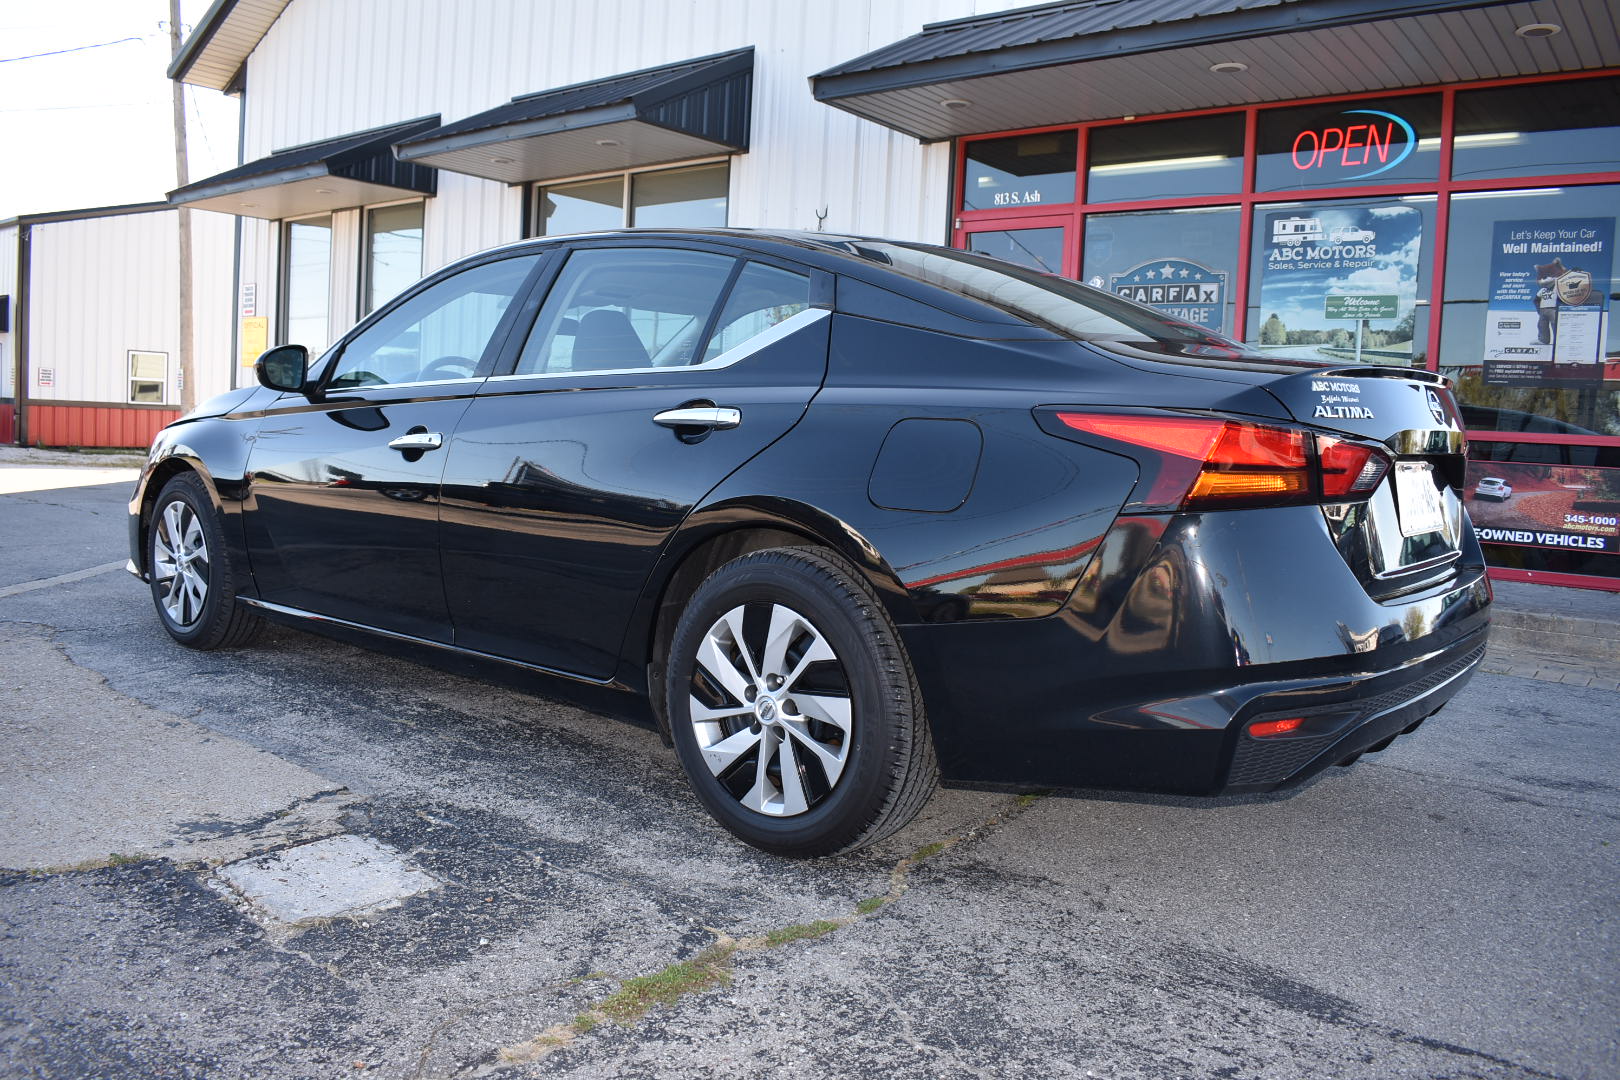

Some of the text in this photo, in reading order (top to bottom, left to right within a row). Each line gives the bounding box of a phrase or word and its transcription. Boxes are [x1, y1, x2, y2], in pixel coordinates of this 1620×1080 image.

[1292, 122, 1393, 170] OPEN
[994, 190, 1041, 205] 813 S. Ash
[1511, 228, 1596, 240] Let's Keep Your Car
[1269, 244, 1376, 261] ABC MOTORS
[1502, 241, 1603, 254] Well Maintained!
[1268, 262, 1295, 271] Sales,
[1297, 261, 1332, 269] Service
[1343, 259, 1374, 269] Repair
[1119, 287, 1215, 302] CARFAX
[1343, 296, 1380, 306] Welcome
[1312, 381, 1361, 394] ABC MOTORS
[1313, 405, 1375, 418] ALTIMA
[1564, 514, 1617, 526] 345-1000
[1562, 523, 1616, 533] abcmotors.com
[1475, 528, 1605, 549] E-OWNED VEHICLES
